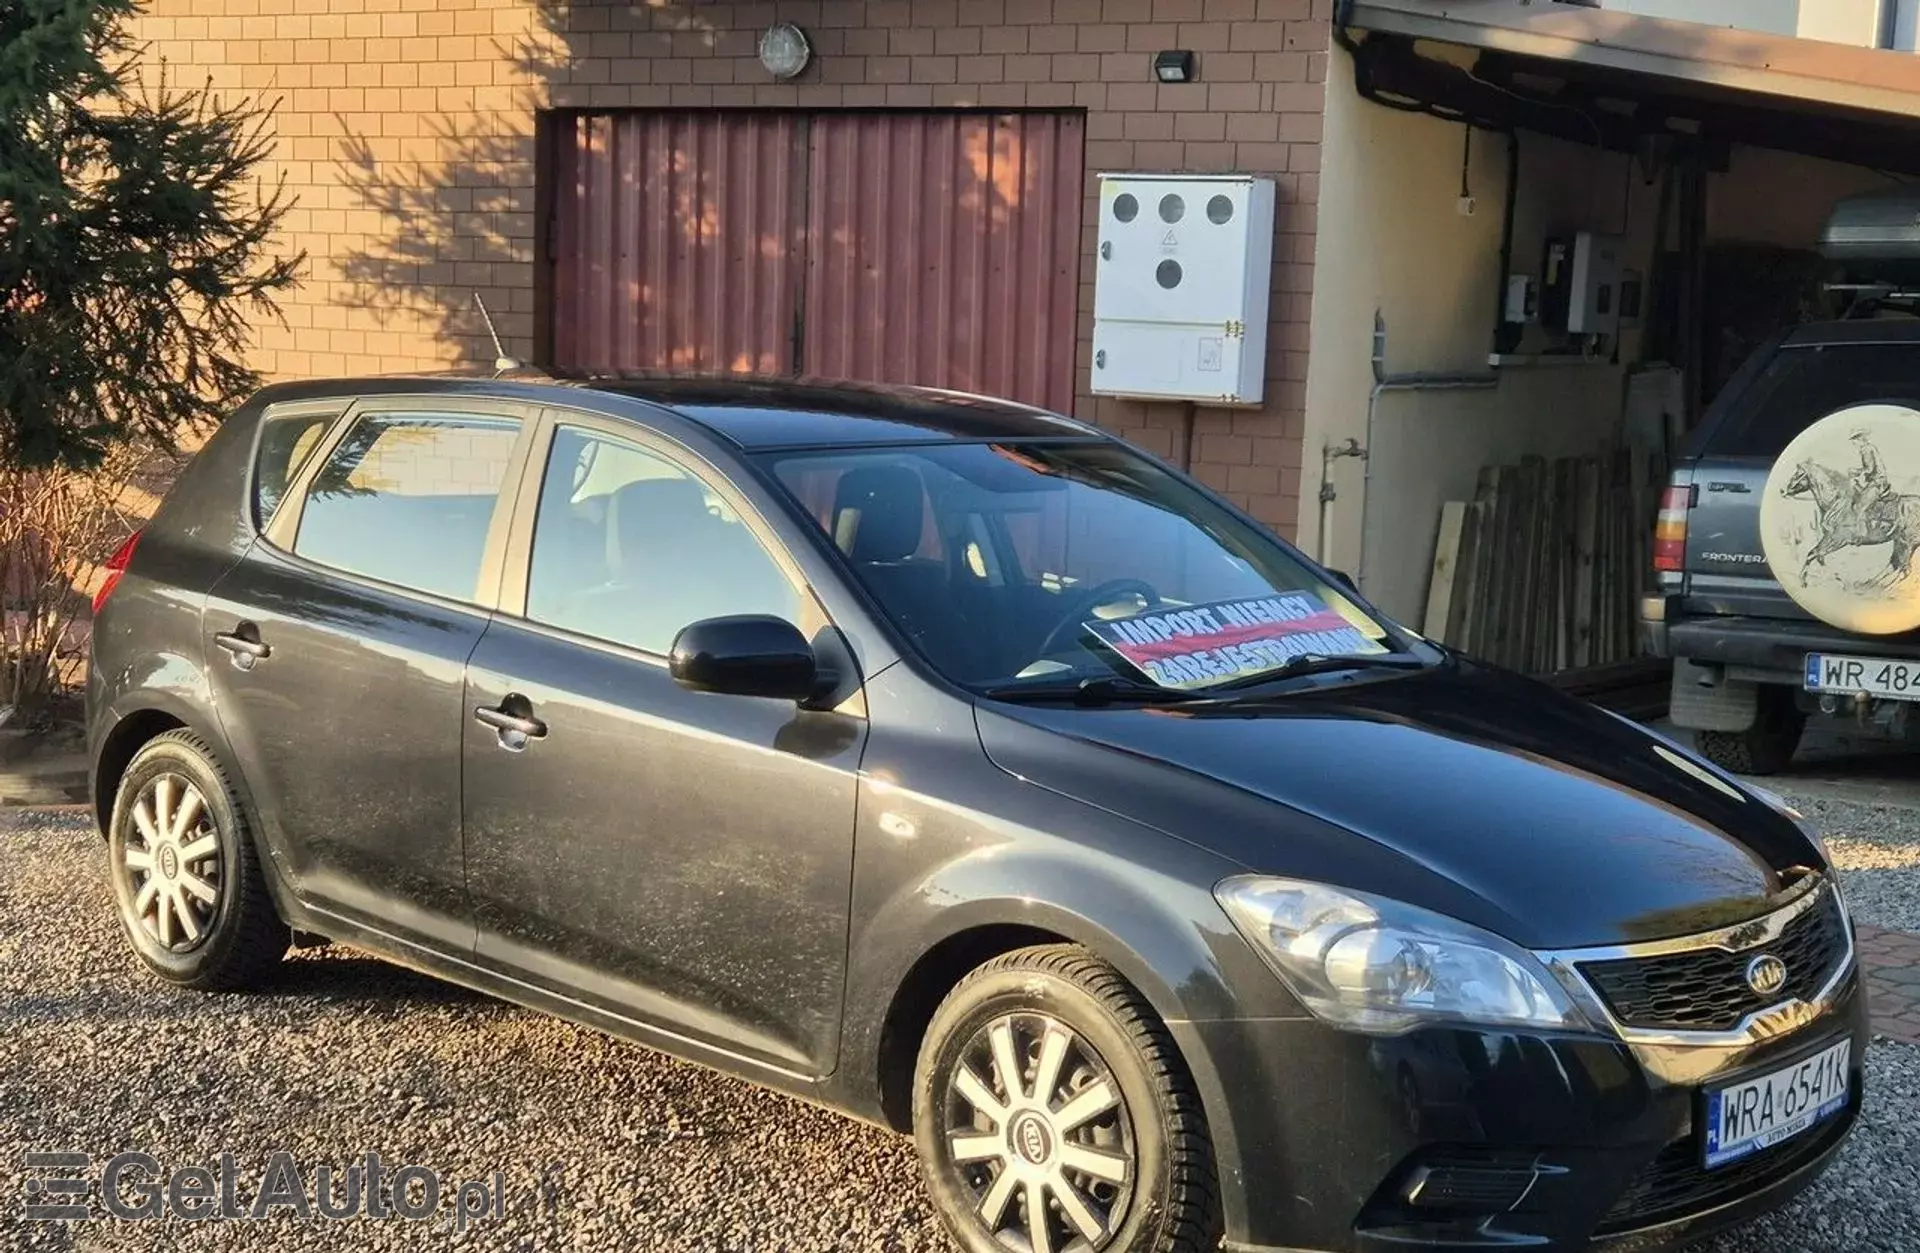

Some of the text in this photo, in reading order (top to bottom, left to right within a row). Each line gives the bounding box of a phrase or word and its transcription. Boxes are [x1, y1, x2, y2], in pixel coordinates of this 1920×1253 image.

[1110, 594, 1317, 646] IMPORT NIEMCY
[1143, 625, 1374, 684] ZAREJESTROWAN
[1825, 659, 1865, 688] WR
[1724, 1043, 1848, 1143] WRA 6541K
[1707, 1129, 1718, 1145] PL
